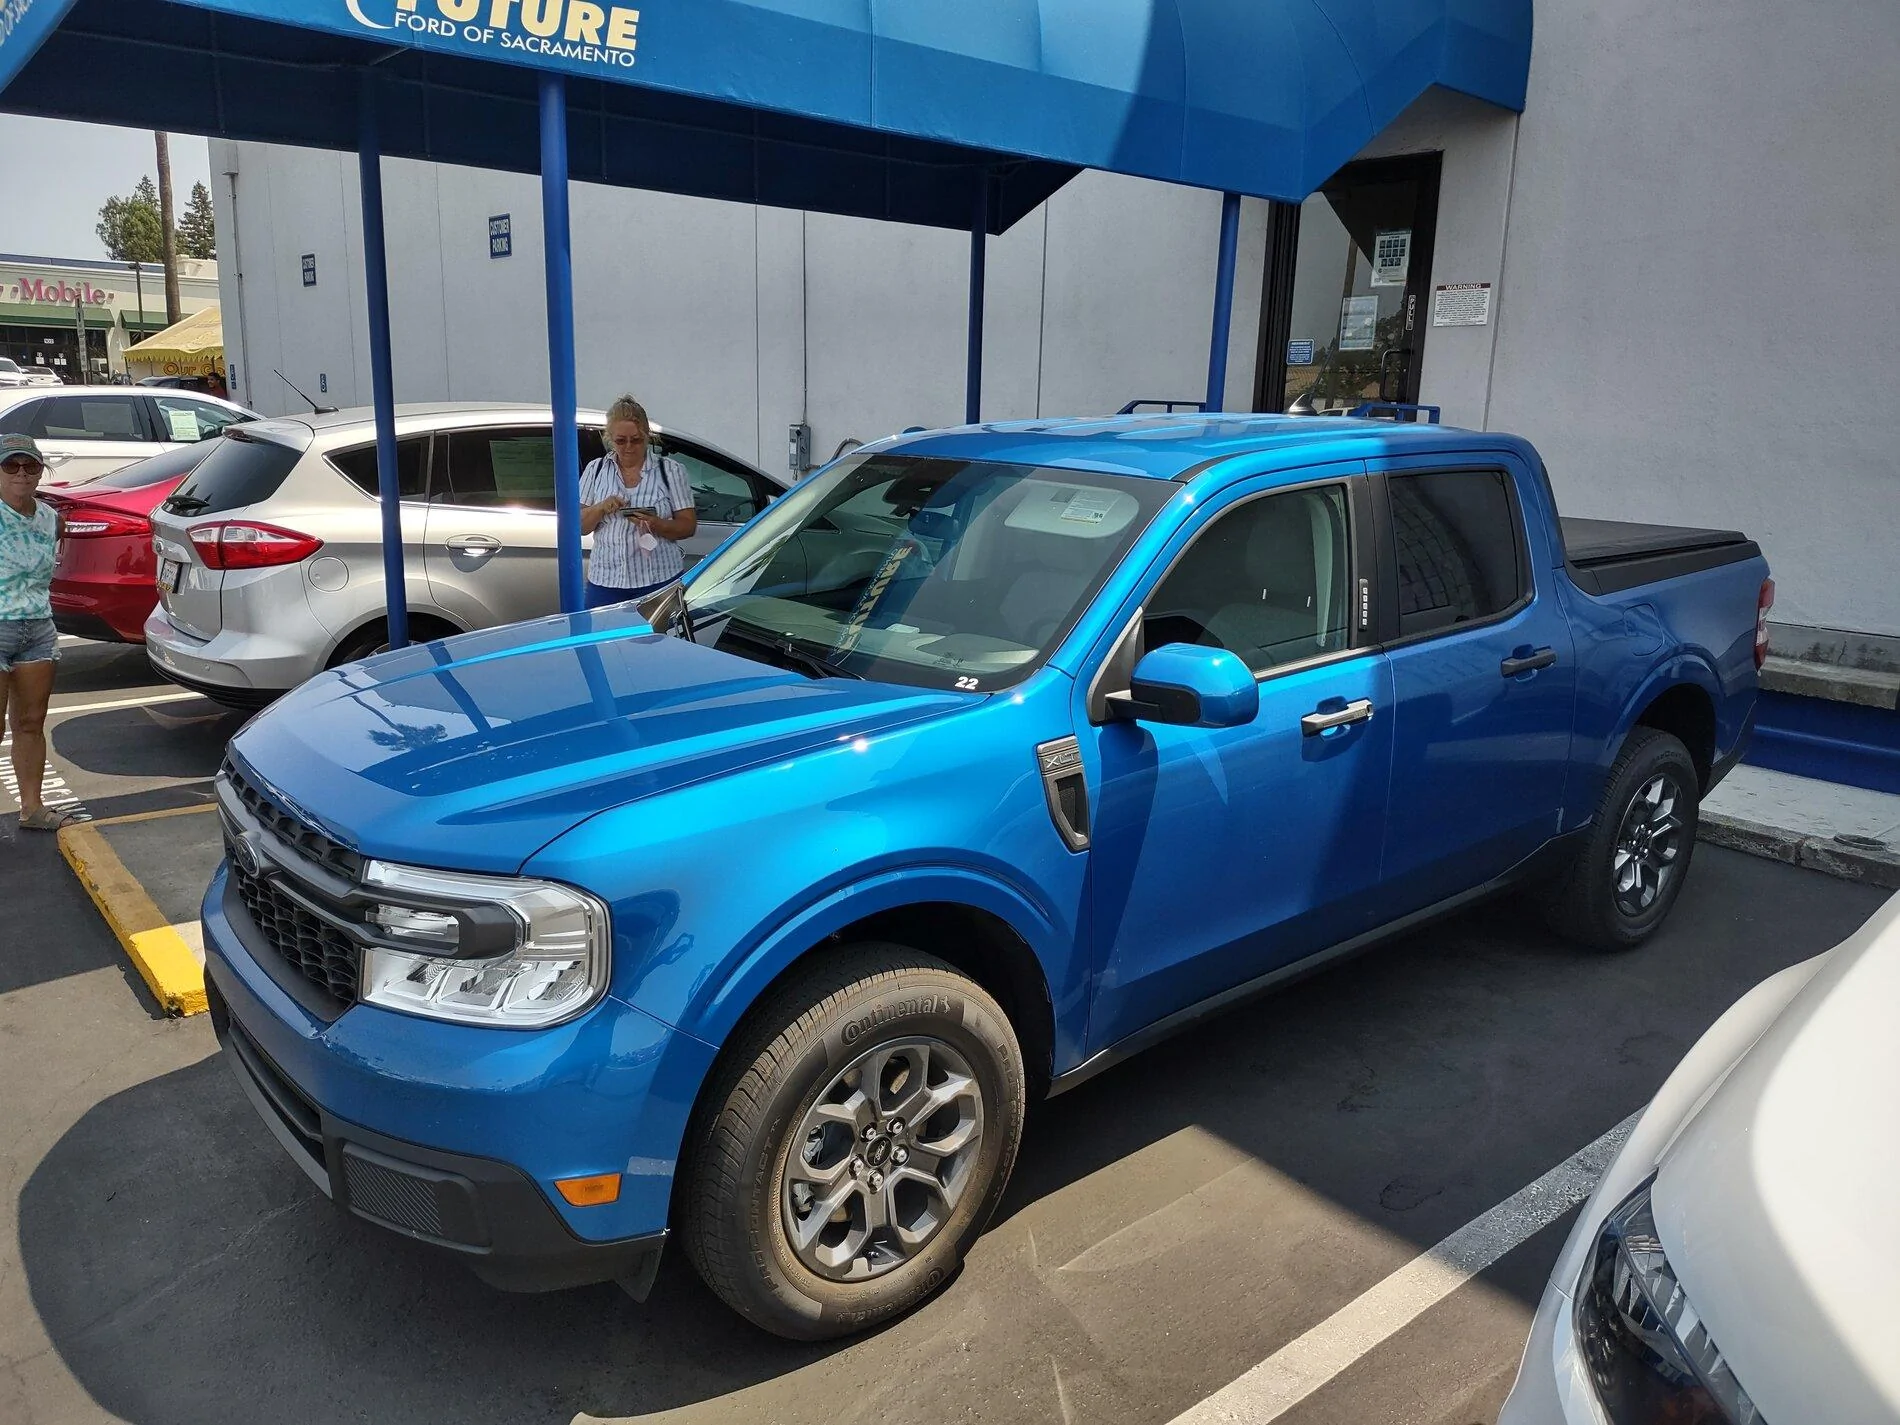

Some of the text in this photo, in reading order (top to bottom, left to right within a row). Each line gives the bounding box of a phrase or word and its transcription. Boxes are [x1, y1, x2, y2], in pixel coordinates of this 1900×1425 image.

[394, 11, 635, 67] FORD OF SACRAMENTO
[396, 0, 639, 50] UTURE
[19, 277, 106, 304] Mobile
[954, 676, 979, 690] 22
[1046, 751, 1075, 769] XLT
[841, 995, 938, 1046] Continental
